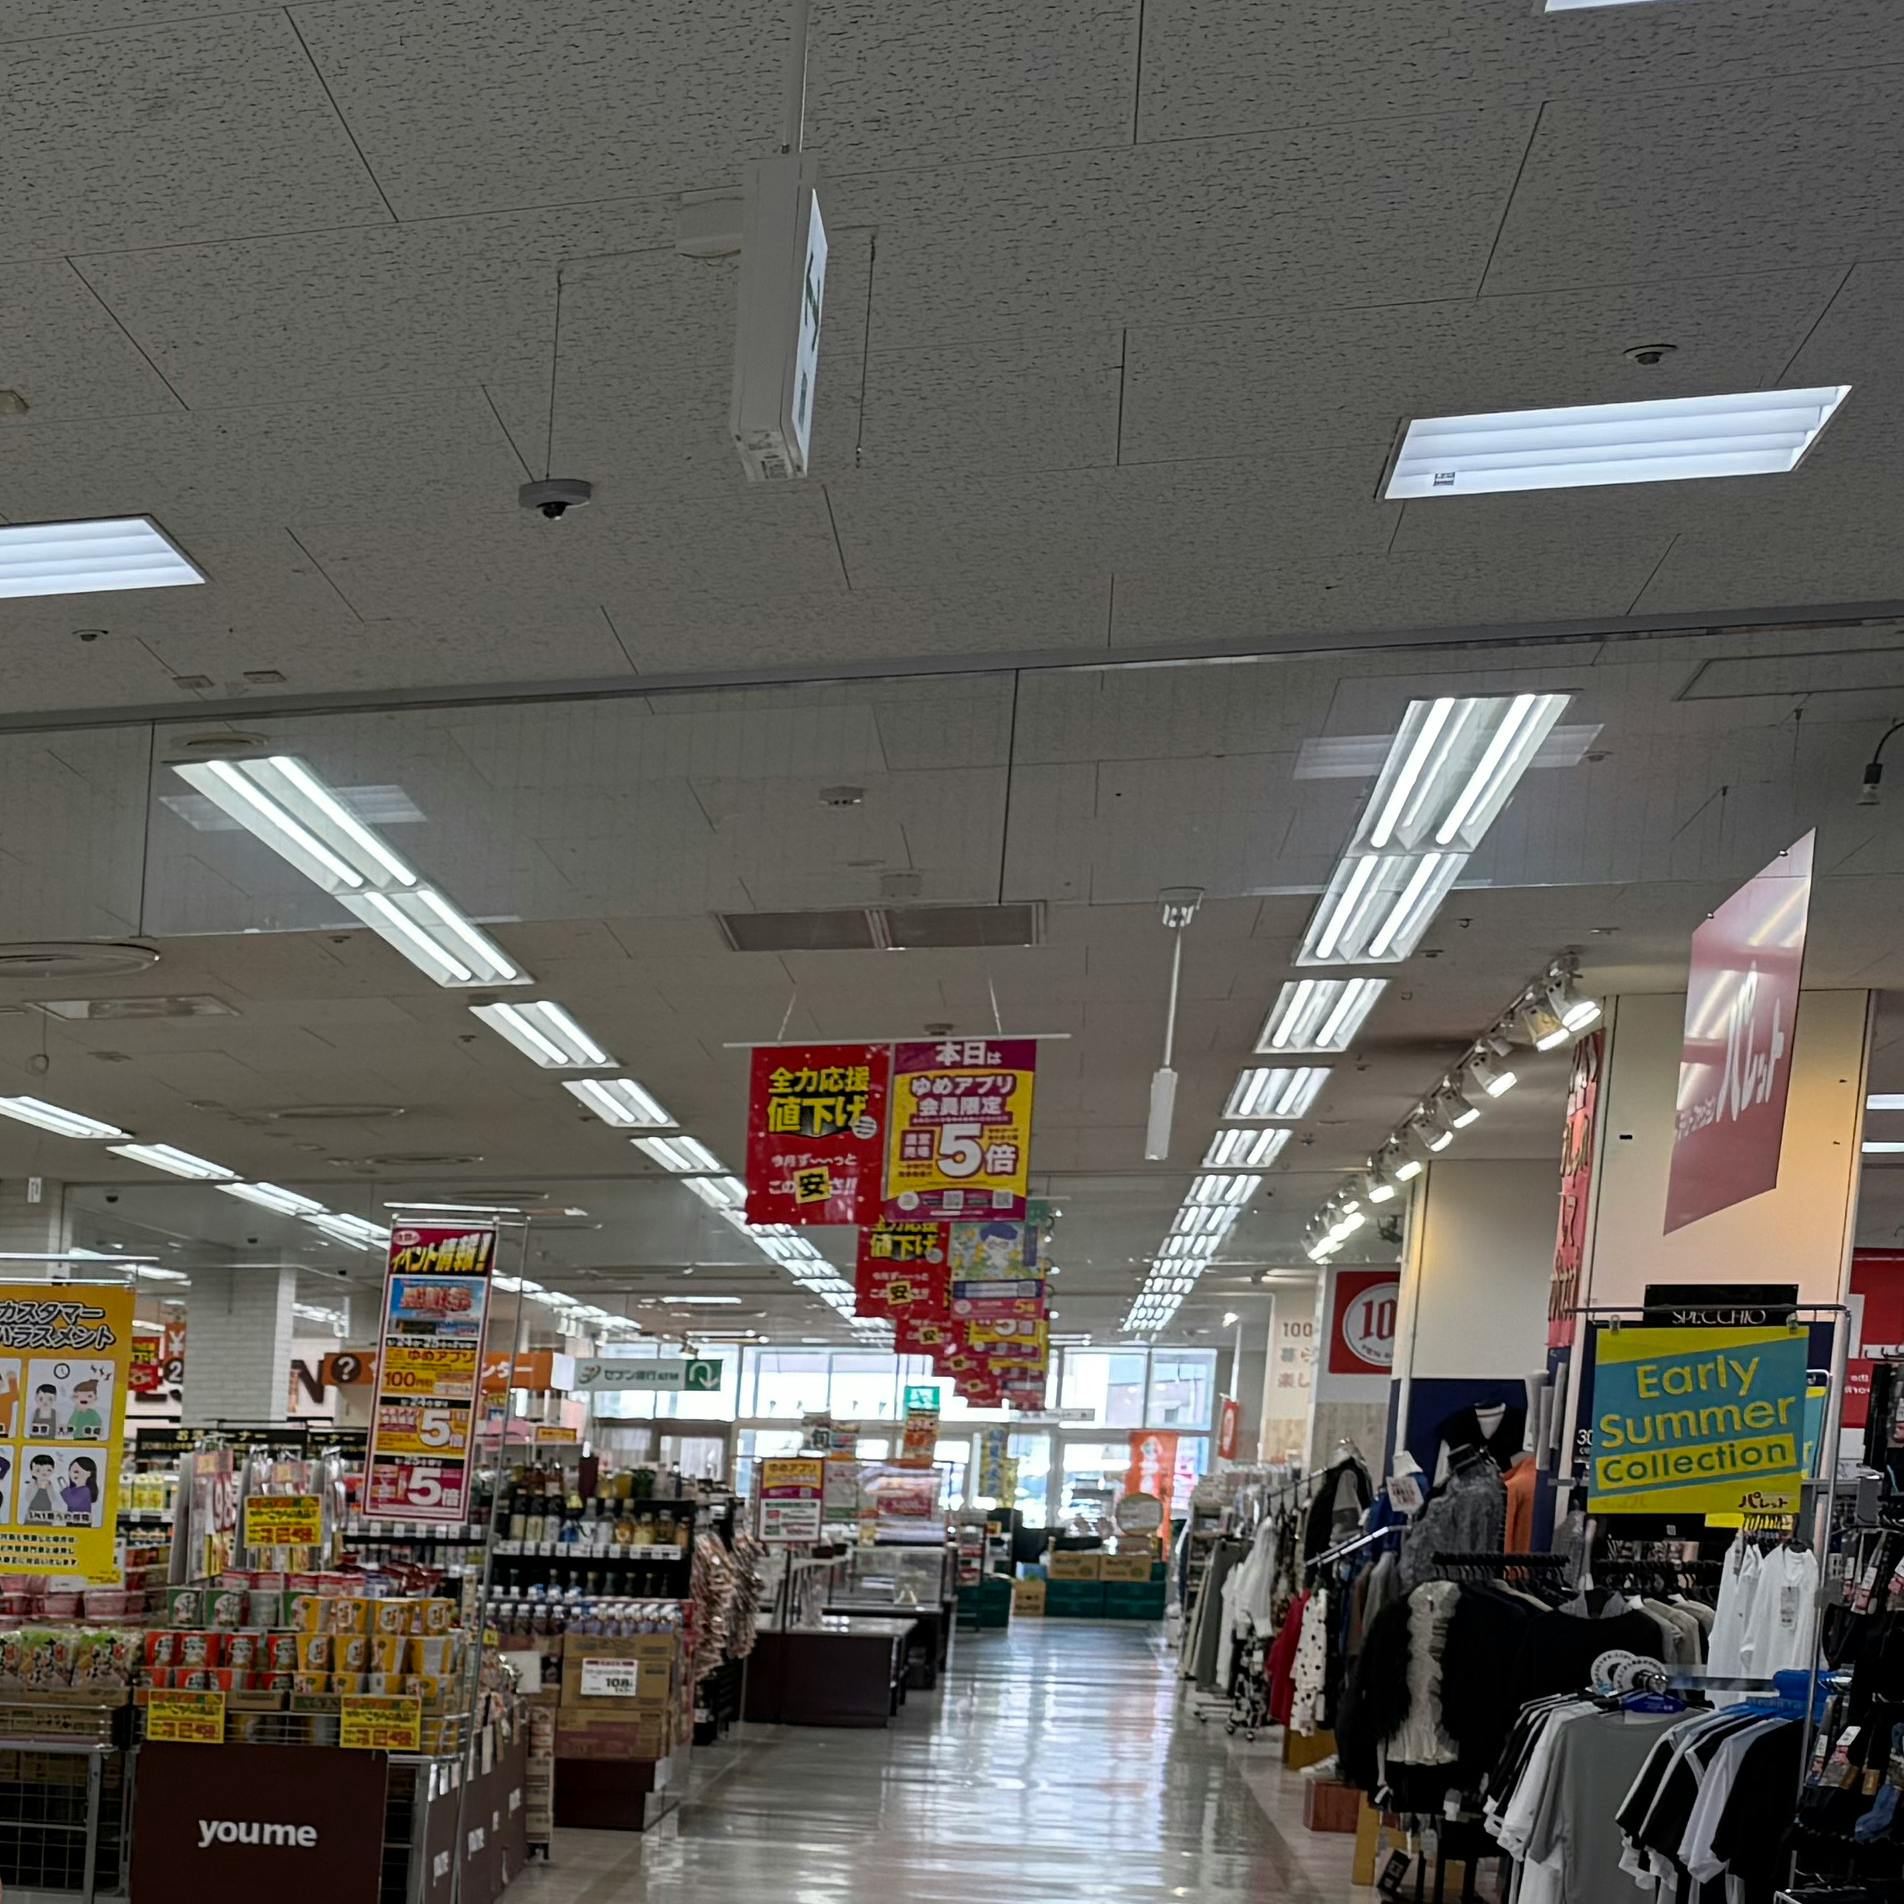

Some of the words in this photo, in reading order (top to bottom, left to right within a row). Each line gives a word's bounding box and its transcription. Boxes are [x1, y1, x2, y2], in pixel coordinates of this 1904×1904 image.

[768, 1067, 871, 1094] 全力応援
[910, 1076, 1015, 1098] ゆめアプリ
[768, 1095, 870, 1136] 値下げ
[918, 1097, 1004, 1118] 会員限定
[870, 1234, 938, 1260] 値下げ
[1282, 1322, 1313, 1337] 100
[1635, 1355, 1761, 1399] Early
[1599, 1395, 1797, 1448] Summer
[1602, 1441, 1788, 1483] Collection
[1738, 1491, 1789, 1509] パレット
[198, 1818, 318, 1848] youme
